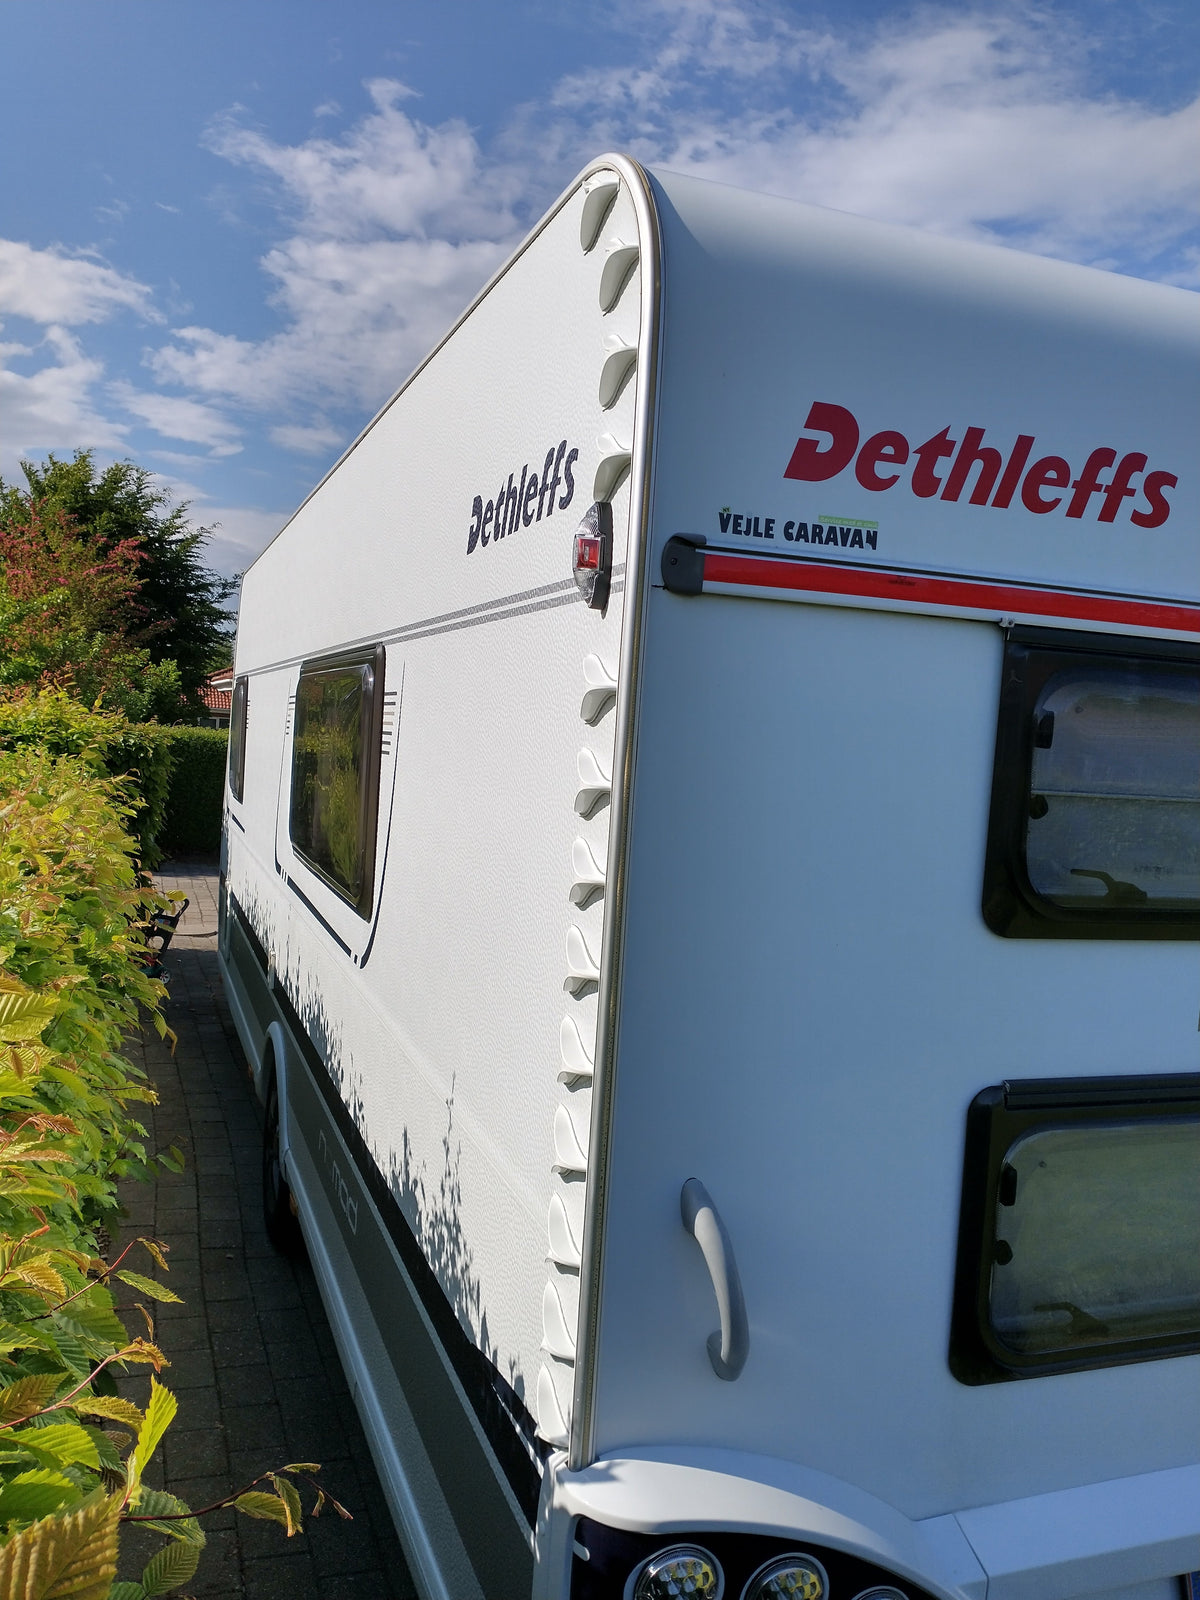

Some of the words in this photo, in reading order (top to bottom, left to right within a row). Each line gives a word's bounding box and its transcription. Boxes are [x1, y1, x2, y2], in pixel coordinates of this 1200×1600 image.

[467, 439, 579, 555] Dethleffs
[784, 401, 1178, 528] Dethleffs
[718, 512, 776, 539] VEJLE
[783, 520, 878, 550] CARAVAN
